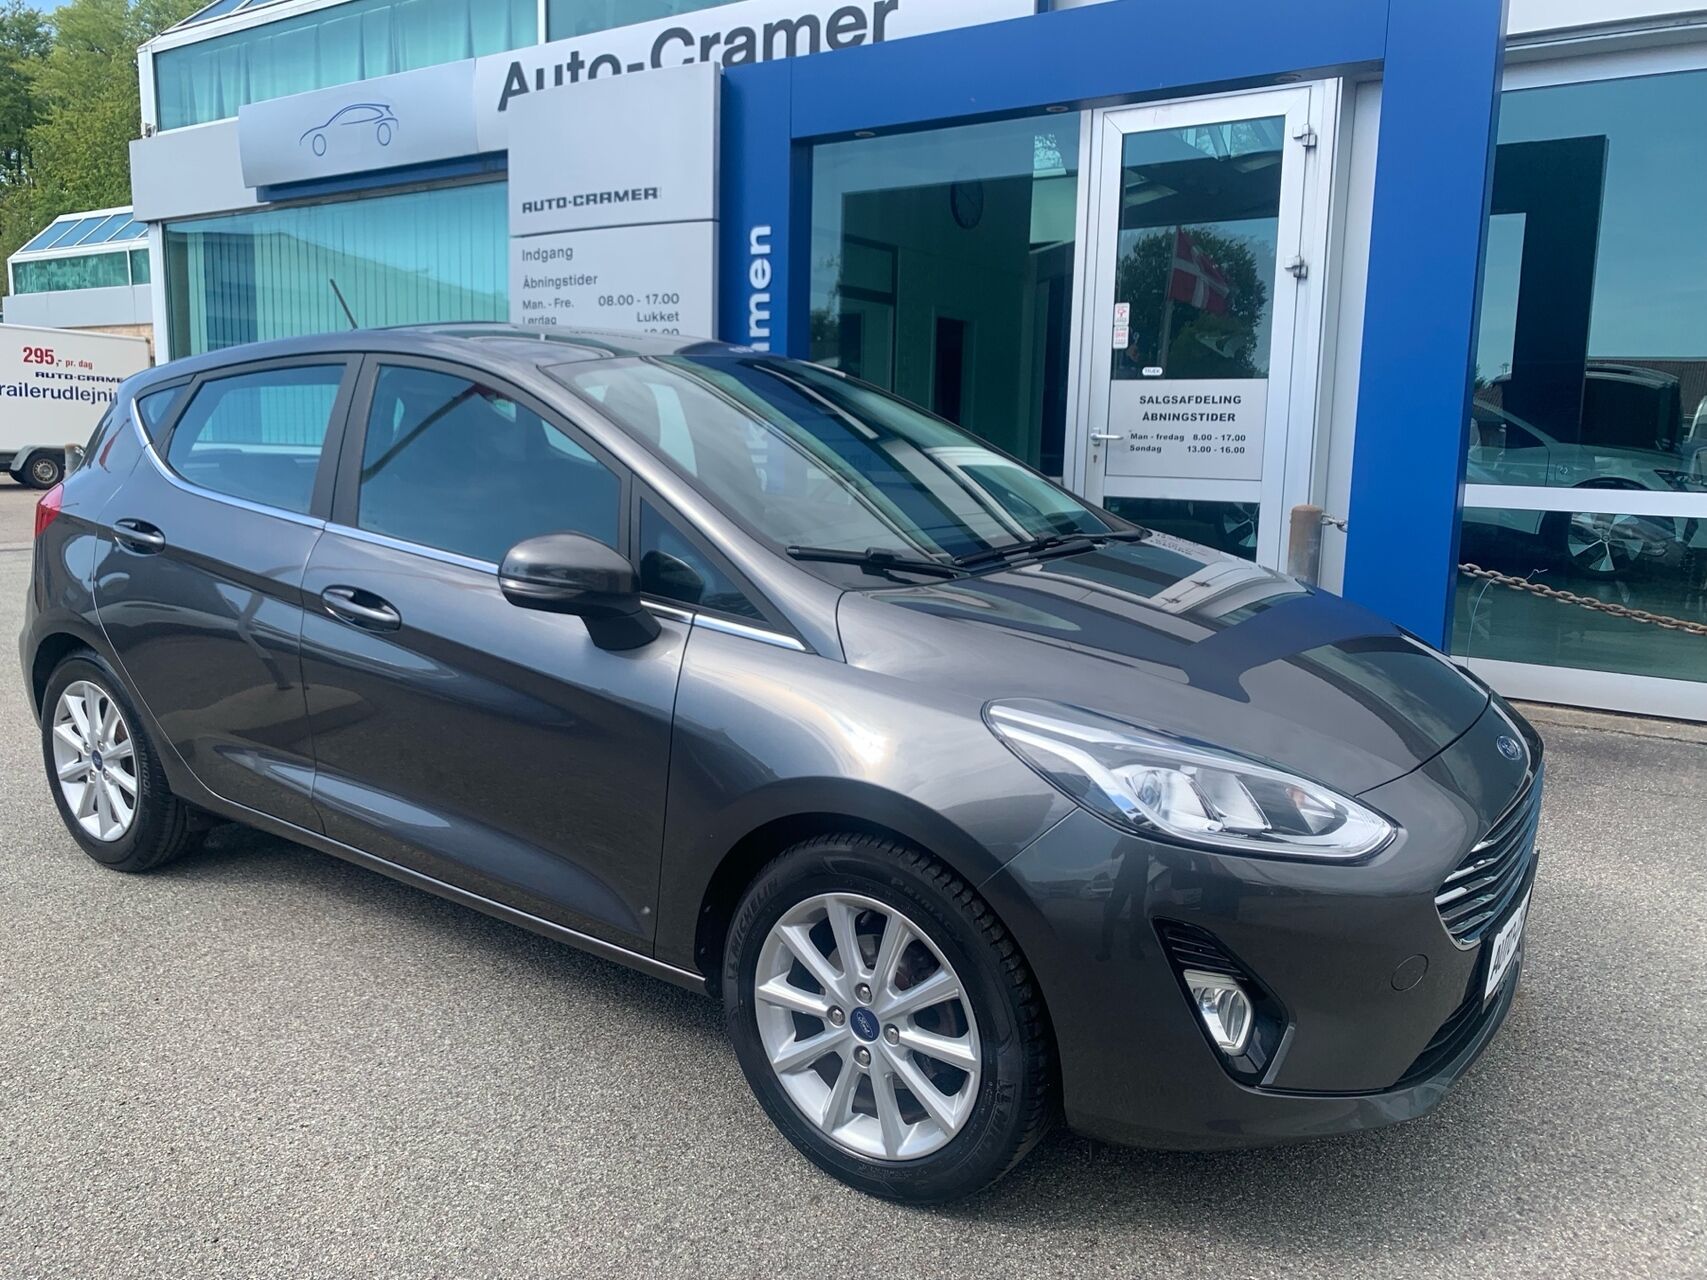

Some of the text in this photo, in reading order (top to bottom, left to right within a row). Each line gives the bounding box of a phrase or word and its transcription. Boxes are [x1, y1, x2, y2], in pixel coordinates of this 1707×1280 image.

[497, 1, 898, 112] Auto-Cramer
[522, 247, 574, 263] Indgang
[523, 273, 598, 290] Åbningstider
[522, 299, 547, 310] Man.
[554, 298, 574, 309] Fre.
[598, 295, 634, 307] 08.00
[645, 293, 680, 305] 17.00
[636, 312, 680, 323] Lukket
[65, 360, 76, 368] pr.
[79, 359, 93, 370] dag
[1139, 395, 1242, 405] SALGSAFDELING
[1142, 411, 1236, 422] ÅBNINGSTIDER
[1156, 433, 1185, 442] fredag
[1221, 434, 1246, 442] 17.00
[1129, 444, 1162, 454] Søndag
[1187, 445, 1212, 453] 13.00
[1220, 446, 1245, 454] 16.00
[730, 877, 780, 958] MICHELIN
